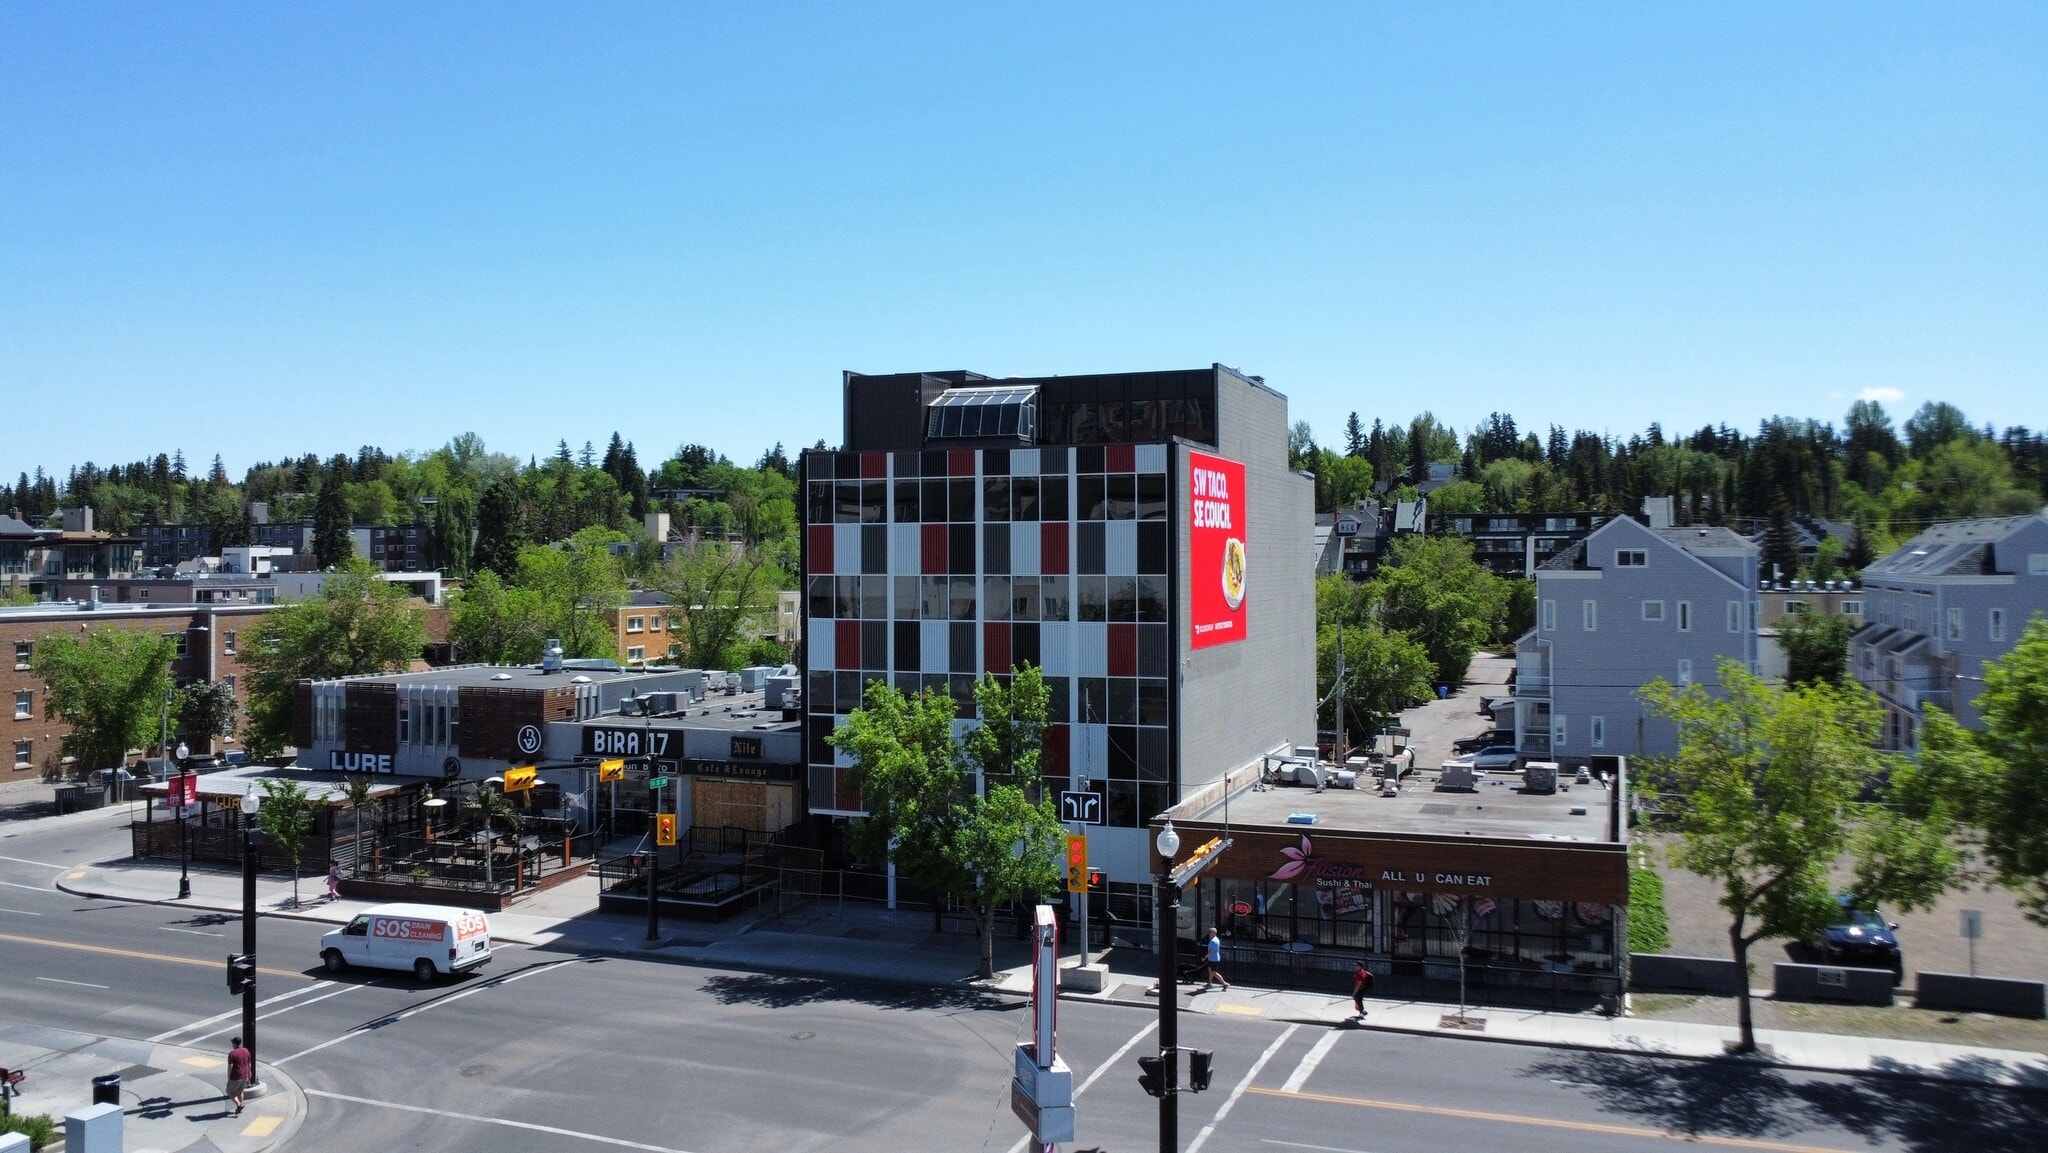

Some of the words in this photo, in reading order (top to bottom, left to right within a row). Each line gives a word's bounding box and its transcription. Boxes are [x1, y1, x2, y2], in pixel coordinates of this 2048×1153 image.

[1194, 467, 1206, 496] SW
[1207, 470, 1229, 499] TACO.
[1194, 499, 1204, 528] SE
[1205, 500, 1232, 529] COUCH.
[649, 732, 669, 756] 17
[733, 741, 756, 755] Nile
[331, 752, 391, 773] LURE
[732, 765, 768, 777] Lounge
[216, 796, 241, 811] LUR
[1316, 878, 1342, 887] Sushi
[1343, 879, 1351, 887] &
[1353, 880, 1372, 888] Thai
[1382, 871, 1406, 881] ALL
[1416, 873, 1425, 882] U
[1435, 873, 1463, 884] CAN
[1467, 875, 1492, 886] EAT
[376, 919, 411, 938] SOS
[411, 922, 431, 930] DRAIN
[457, 915, 484, 935] SOS
[410, 931, 441, 940] CLEANING
